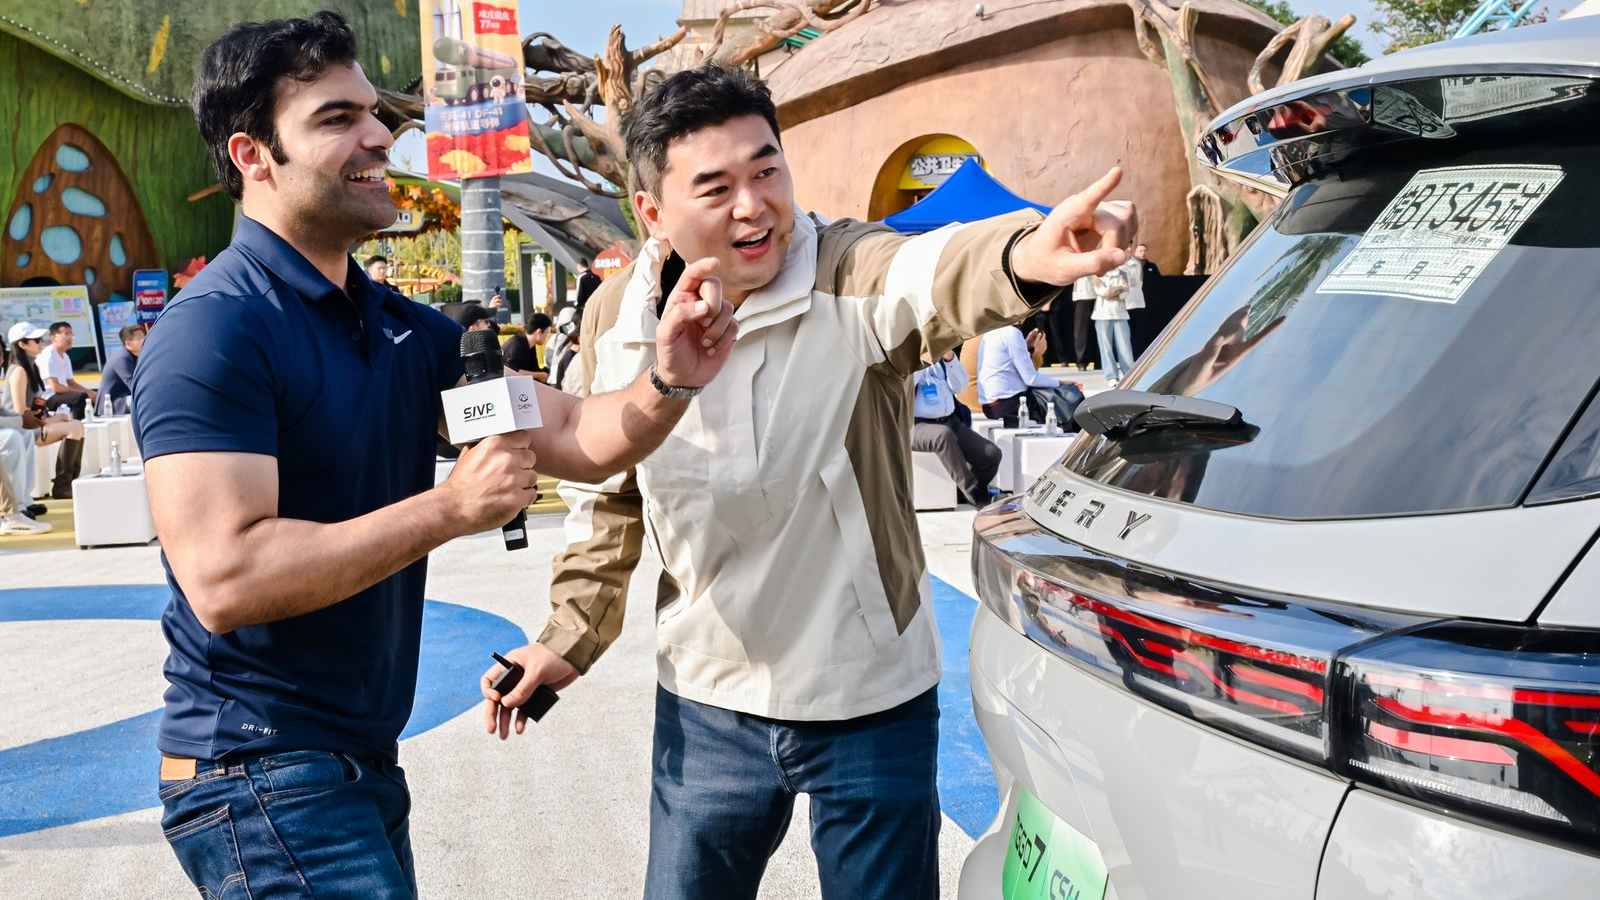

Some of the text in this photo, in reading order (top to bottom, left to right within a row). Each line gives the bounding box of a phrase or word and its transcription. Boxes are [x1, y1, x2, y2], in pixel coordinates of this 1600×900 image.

[475, 107, 503, 119] DF-41
[911, 155, 978, 175] 公共卫生
[1404, 261, 1429, 280] 月
[1449, 265, 1475, 285] 日
[241, 723, 278, 736] DRI-FIT
[1027, 833, 1047, 883] 7
